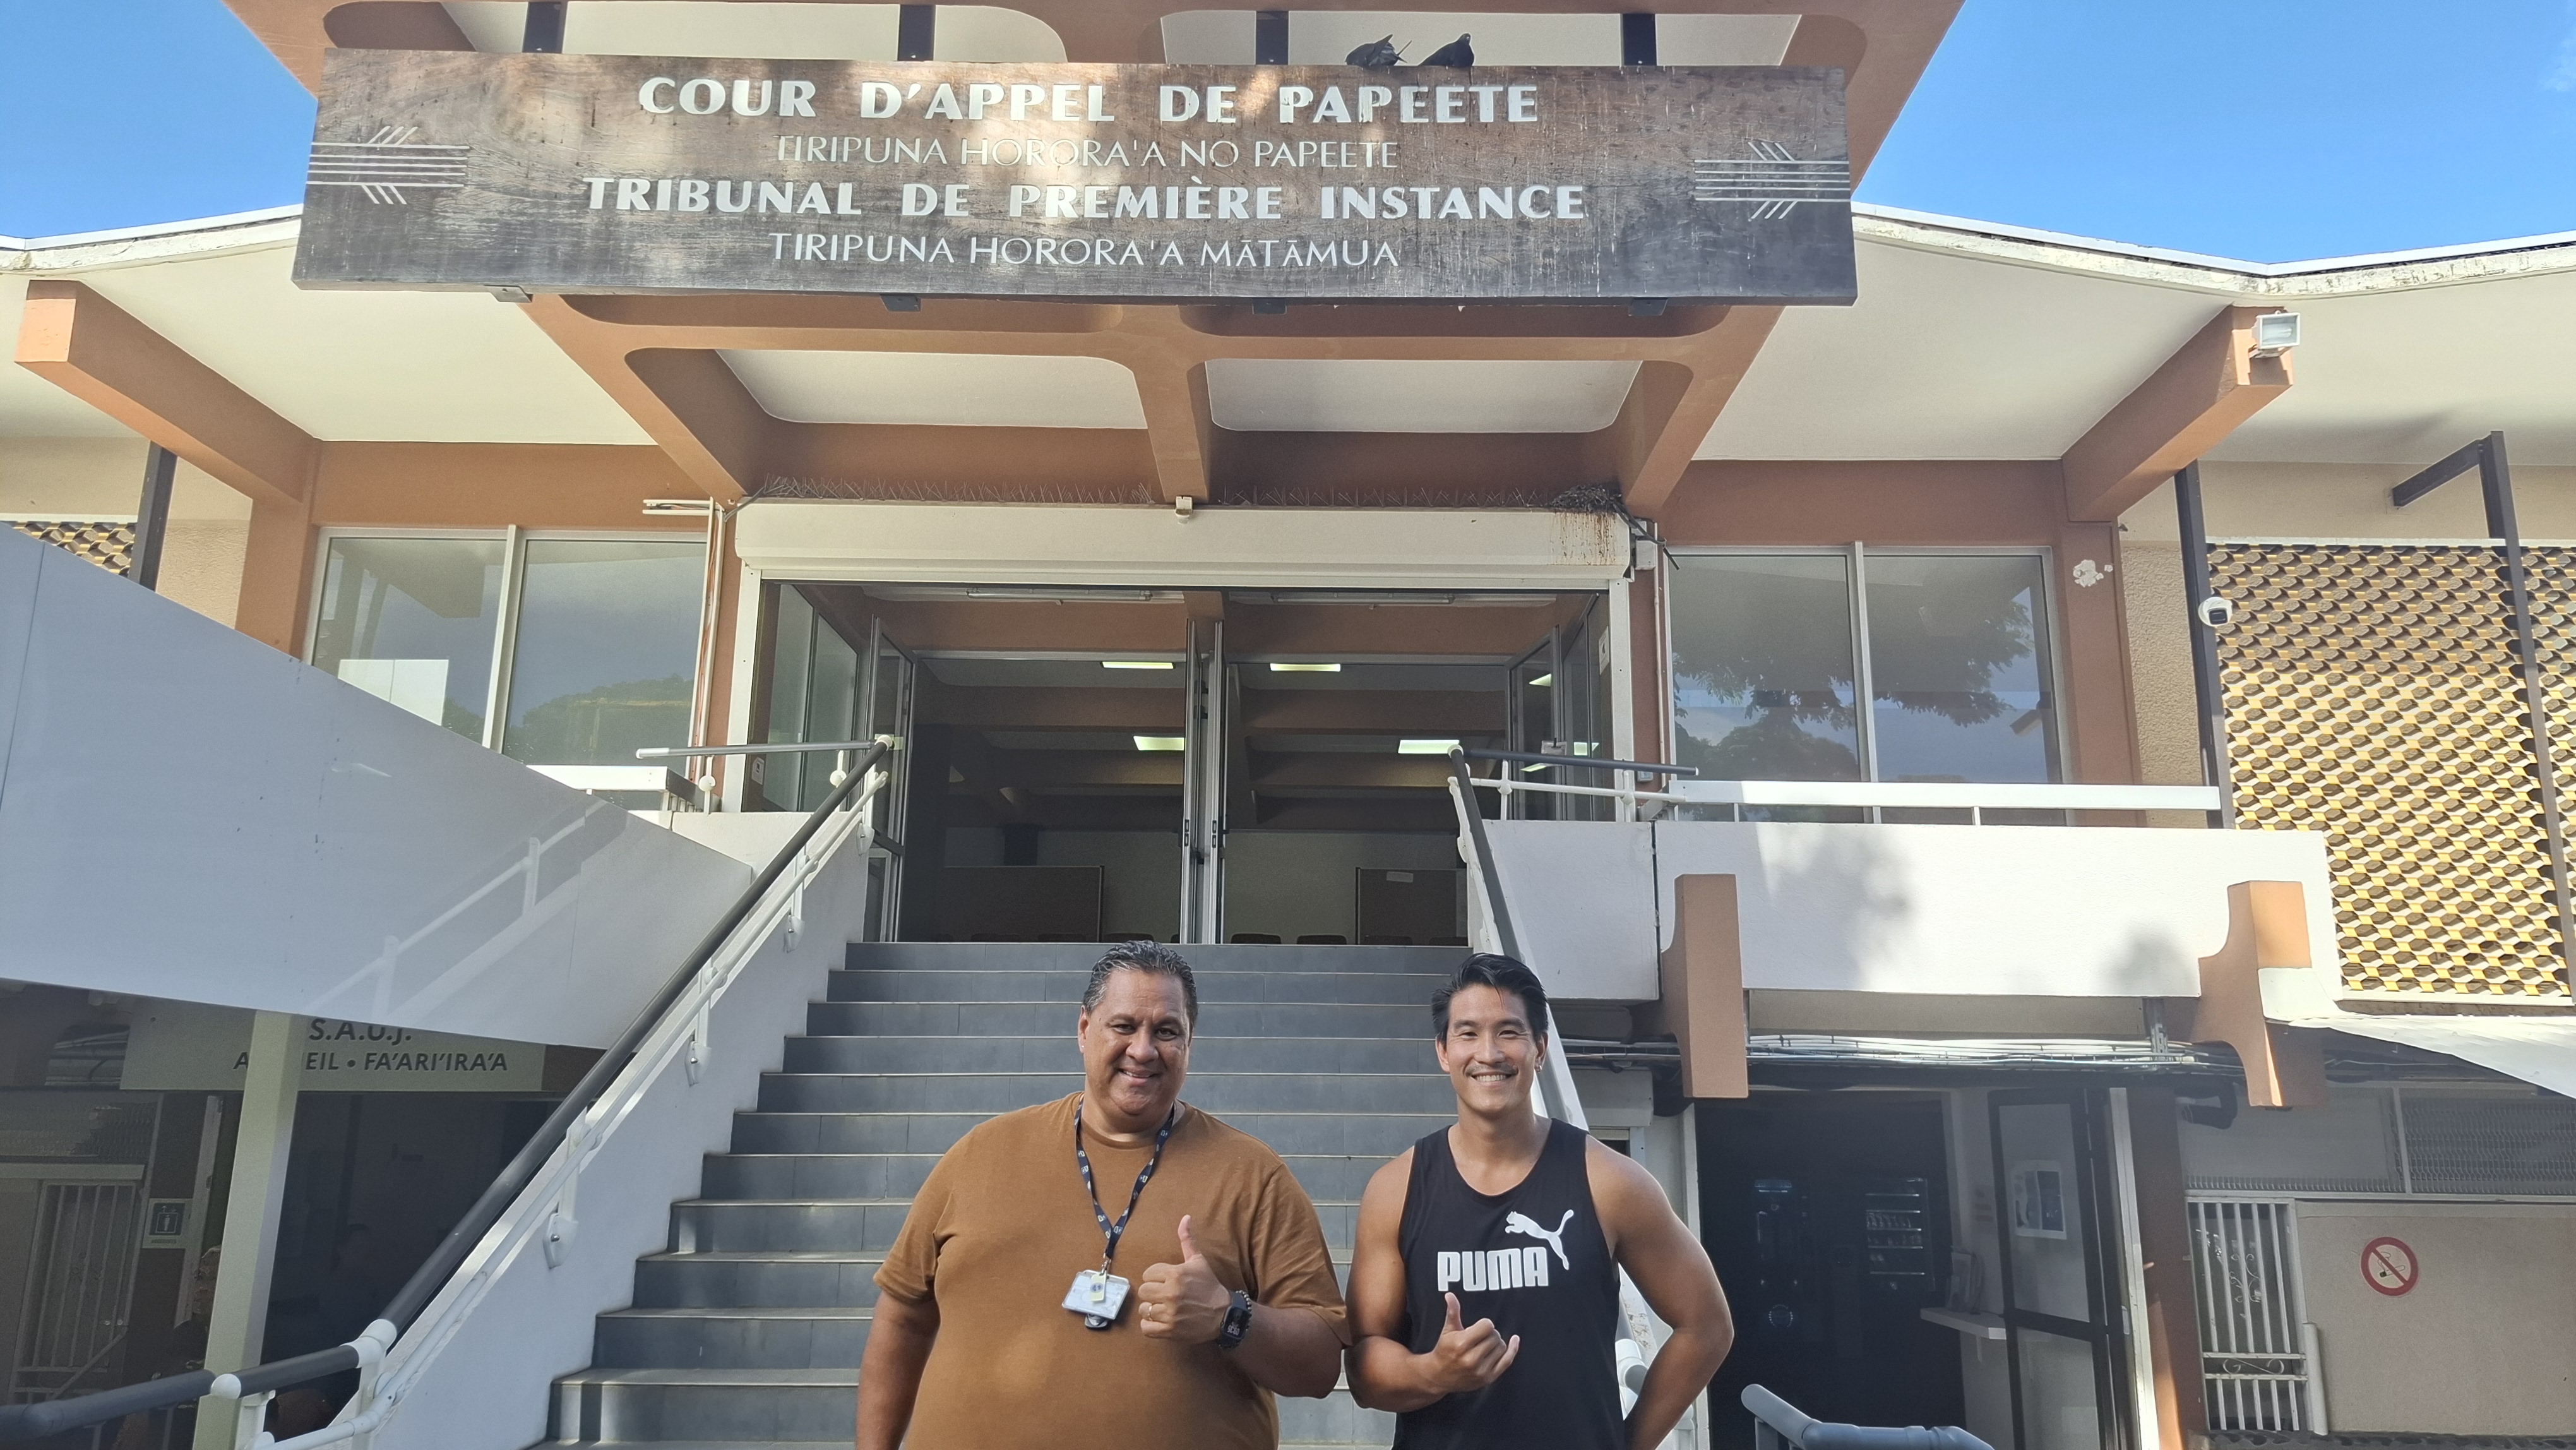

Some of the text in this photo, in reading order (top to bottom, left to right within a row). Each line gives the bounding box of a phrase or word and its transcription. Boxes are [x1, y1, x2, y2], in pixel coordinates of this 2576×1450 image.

[638, 76, 1538, 124] COUR D'APPEL DE PAPEETE
[773, 135, 1398, 168] TIRIPUNA HORORA'A NO PAPEETE
[582, 175, 1584, 220] TRIBUNAL DE PREMIÈRE INSTANCE
[768, 232, 1399, 267] TIRIPUNA HORORA'A MĀTĀMUA
[1437, 1247, 1549, 1291] PUMA
